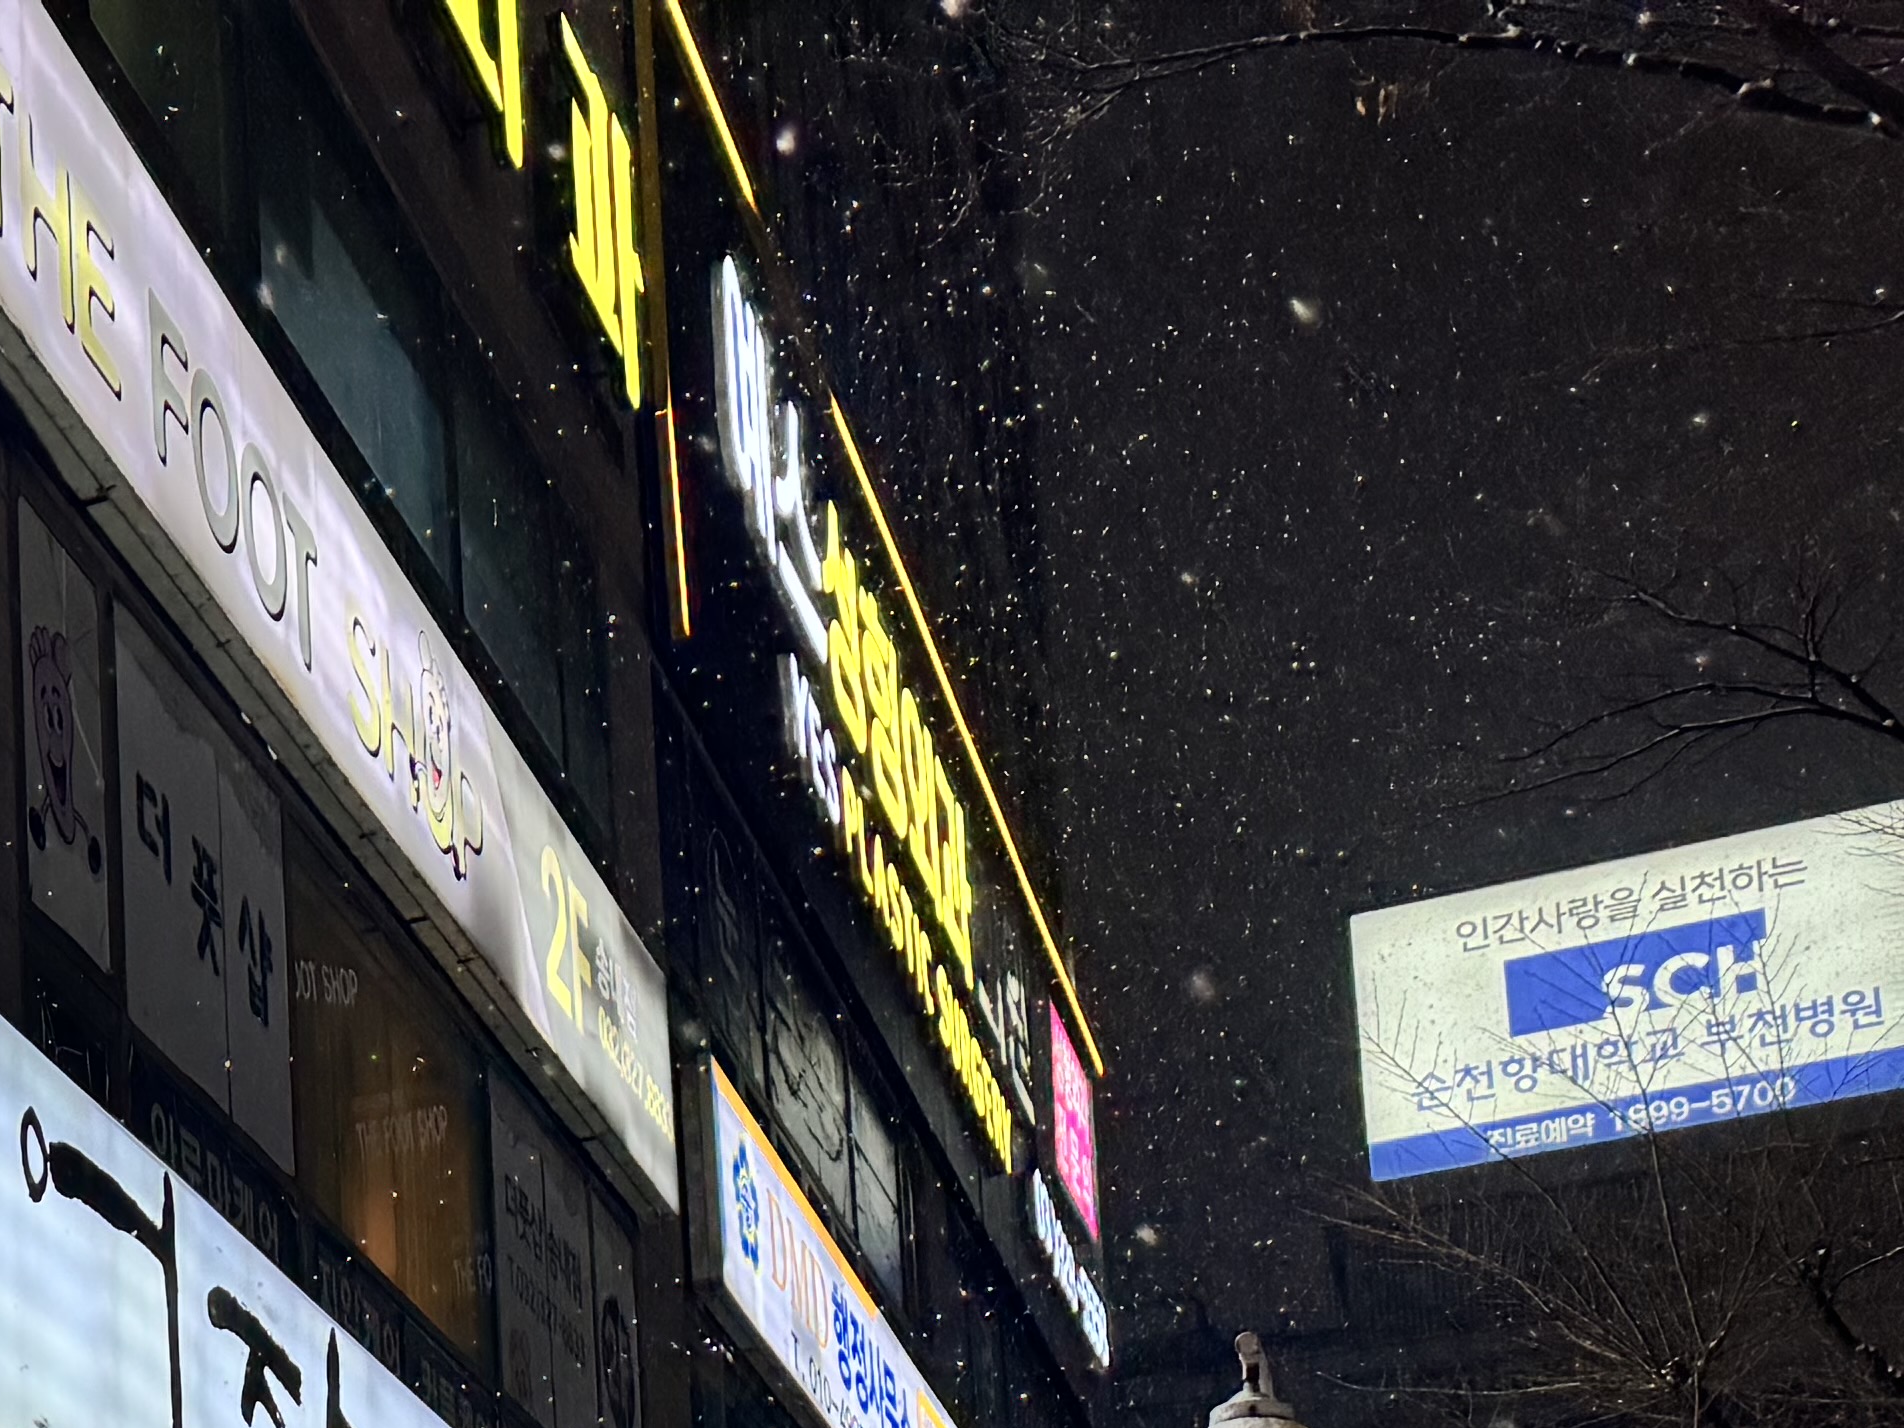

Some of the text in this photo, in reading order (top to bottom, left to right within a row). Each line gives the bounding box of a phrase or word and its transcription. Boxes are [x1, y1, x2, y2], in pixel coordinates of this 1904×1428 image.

[149, 287, 318, 673] FOOT
[1456, 857, 1809, 952] 인간사랑을 실천하는
[1601, 940, 1766, 1019] SCH
[1701, 986, 1885, 1058] 부천병원
